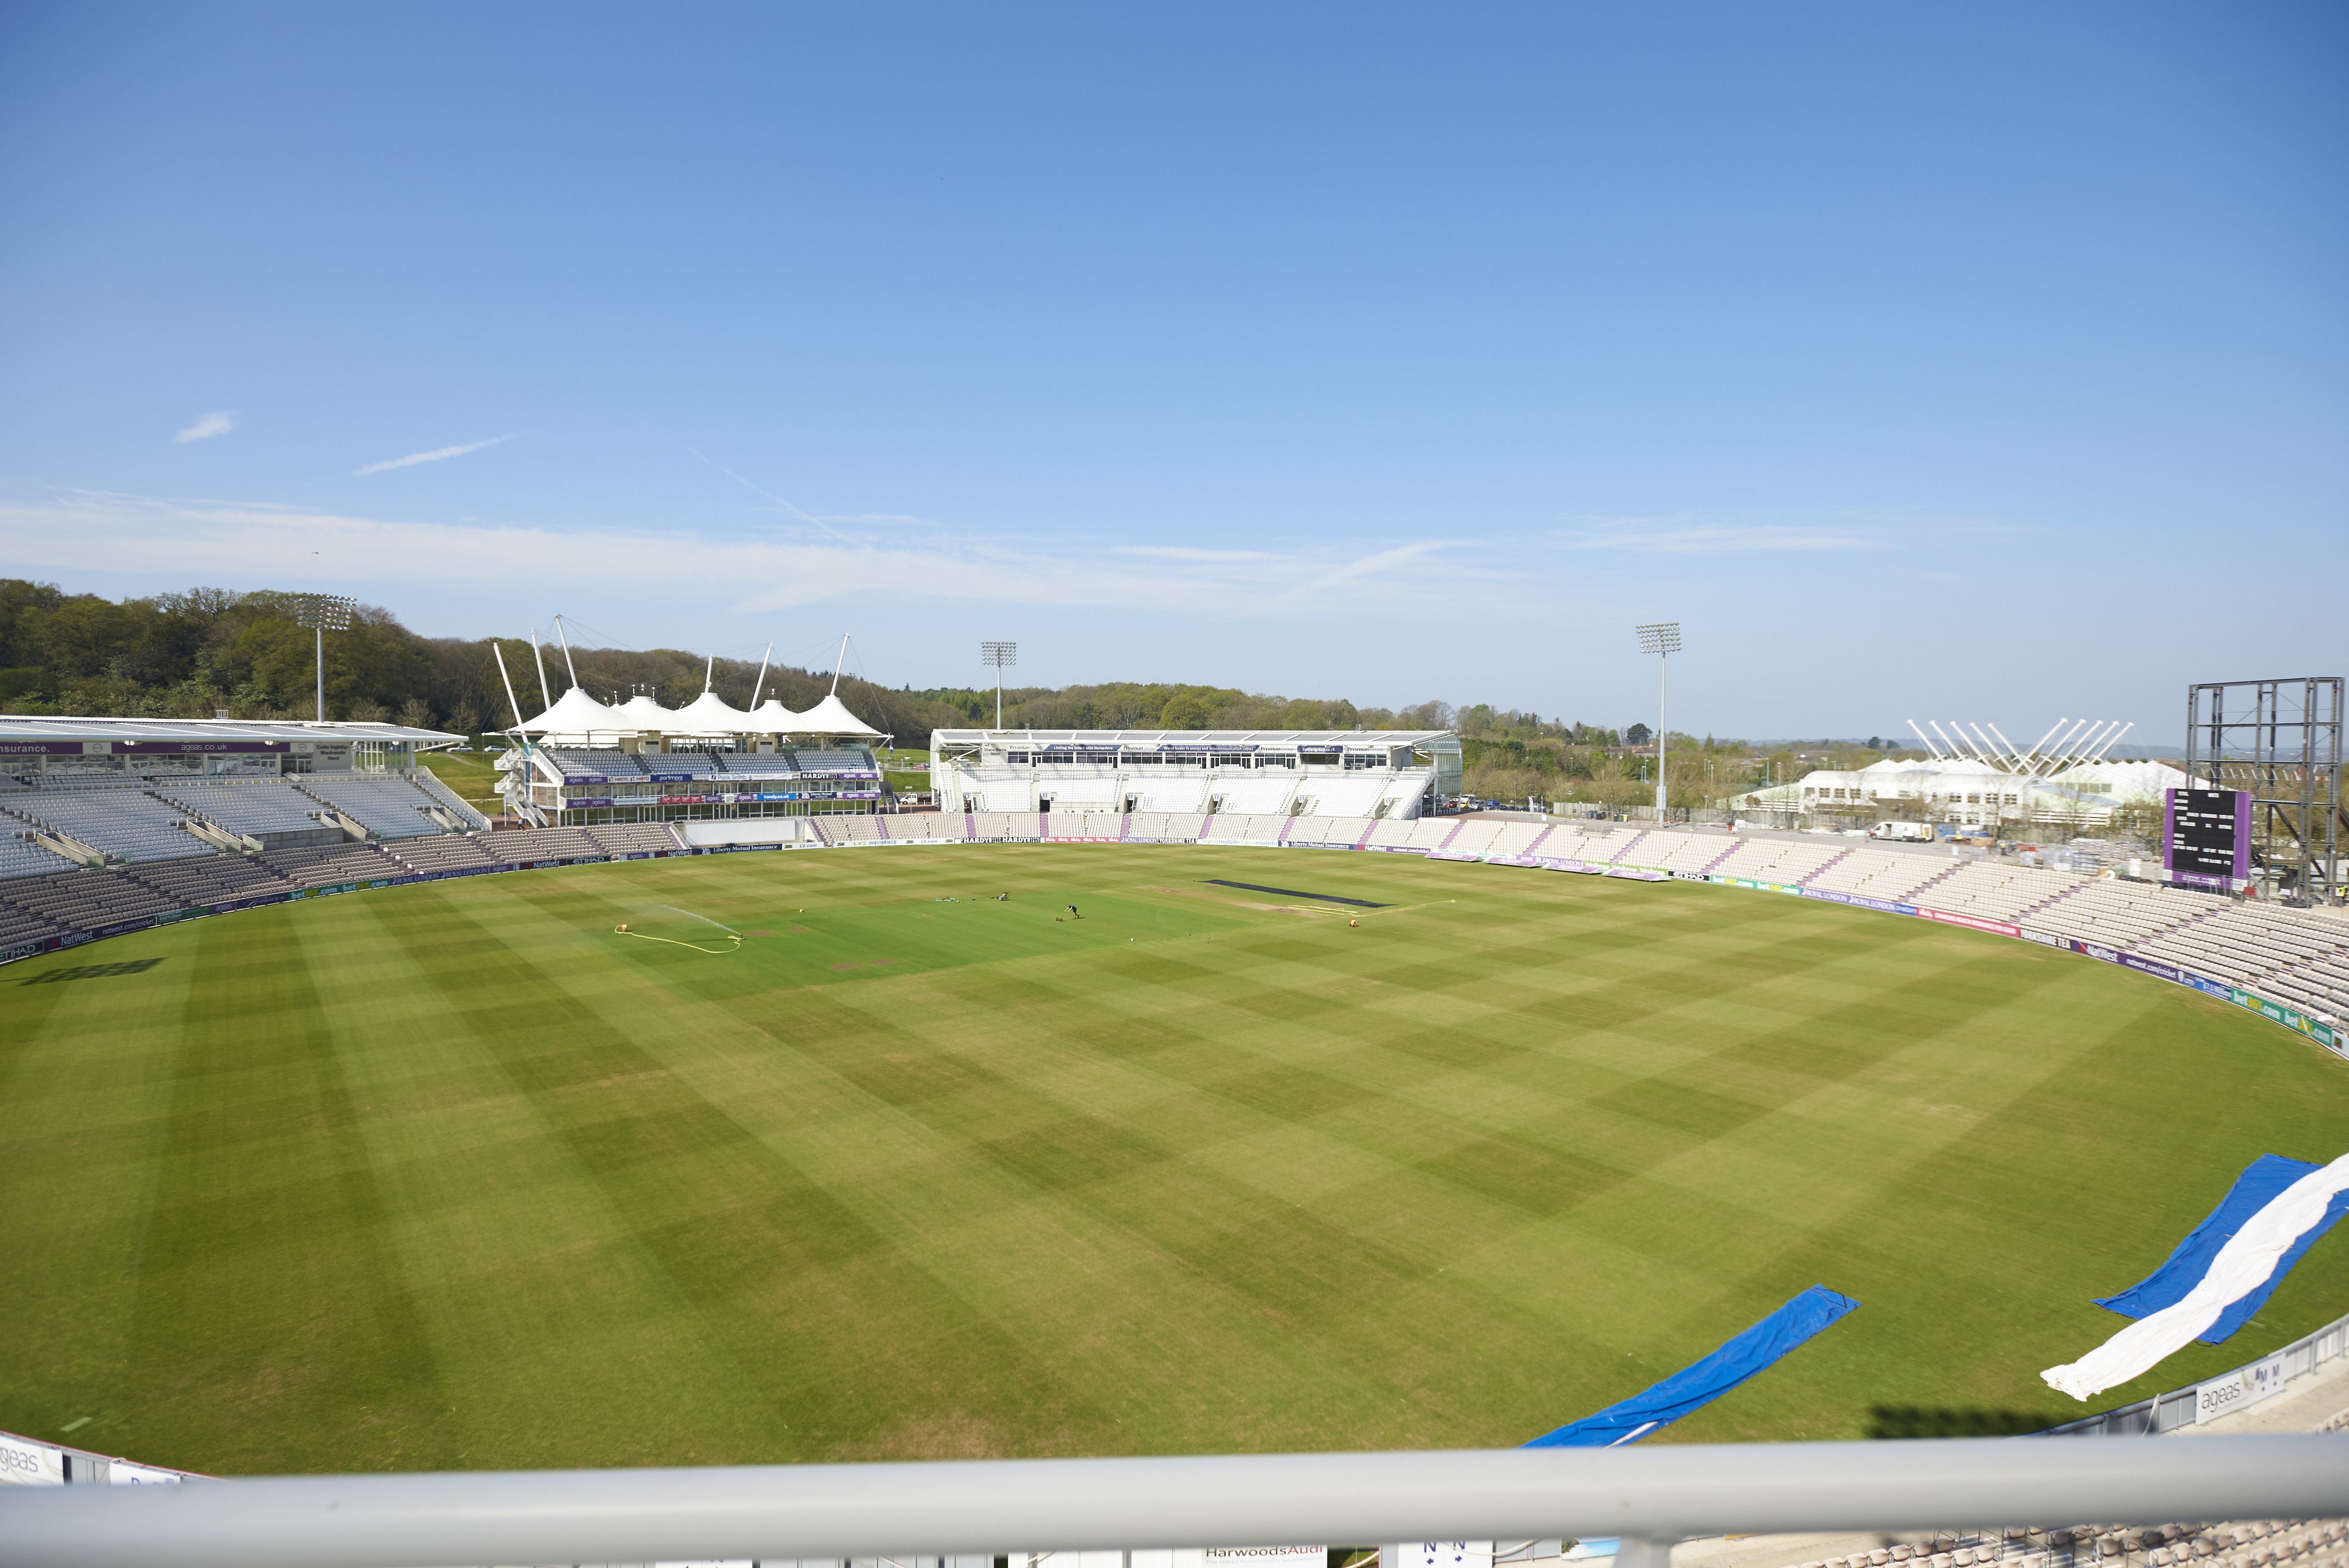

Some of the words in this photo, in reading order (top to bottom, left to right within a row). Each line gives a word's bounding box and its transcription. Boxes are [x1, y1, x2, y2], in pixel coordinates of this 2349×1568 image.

[181, 743, 228, 752] ageas.co.uk
[398, 875, 414, 884] ROYAL
[415, 873, 439, 882] LONDON
[446, 869, 462, 878] ROYAL
[1674, 872, 1704, 880] ETIHAD
[291, 886, 337, 899] bet365.com
[343, 880, 388, 891] bet365.com
[1806, 889, 1824, 899] ROYAL
[1824, 892, 1847, 902] LONDON
[216, 904, 232, 913] ageas
[1854, 897, 1871, 907] ROYAL
[1871, 901, 1895, 911] LONDON
[103, 918, 154, 935] natwest.com/cricket
[61, 929, 94, 946] NatWest
[2021, 928, 2057, 946] YORKSHIRE
[2058, 937, 2071, 949] TEA
[0, 945, 35, 960] ETIHAD
[2087, 945, 2118, 962] NatWest
[2126, 958, 2176, 978] natwest.com/cricket
[2234, 990, 2280, 1020] bet365.com
[2285, 1011, 2331, 1044] bet365.com
[2202, 1382, 2240, 1413] ageas
